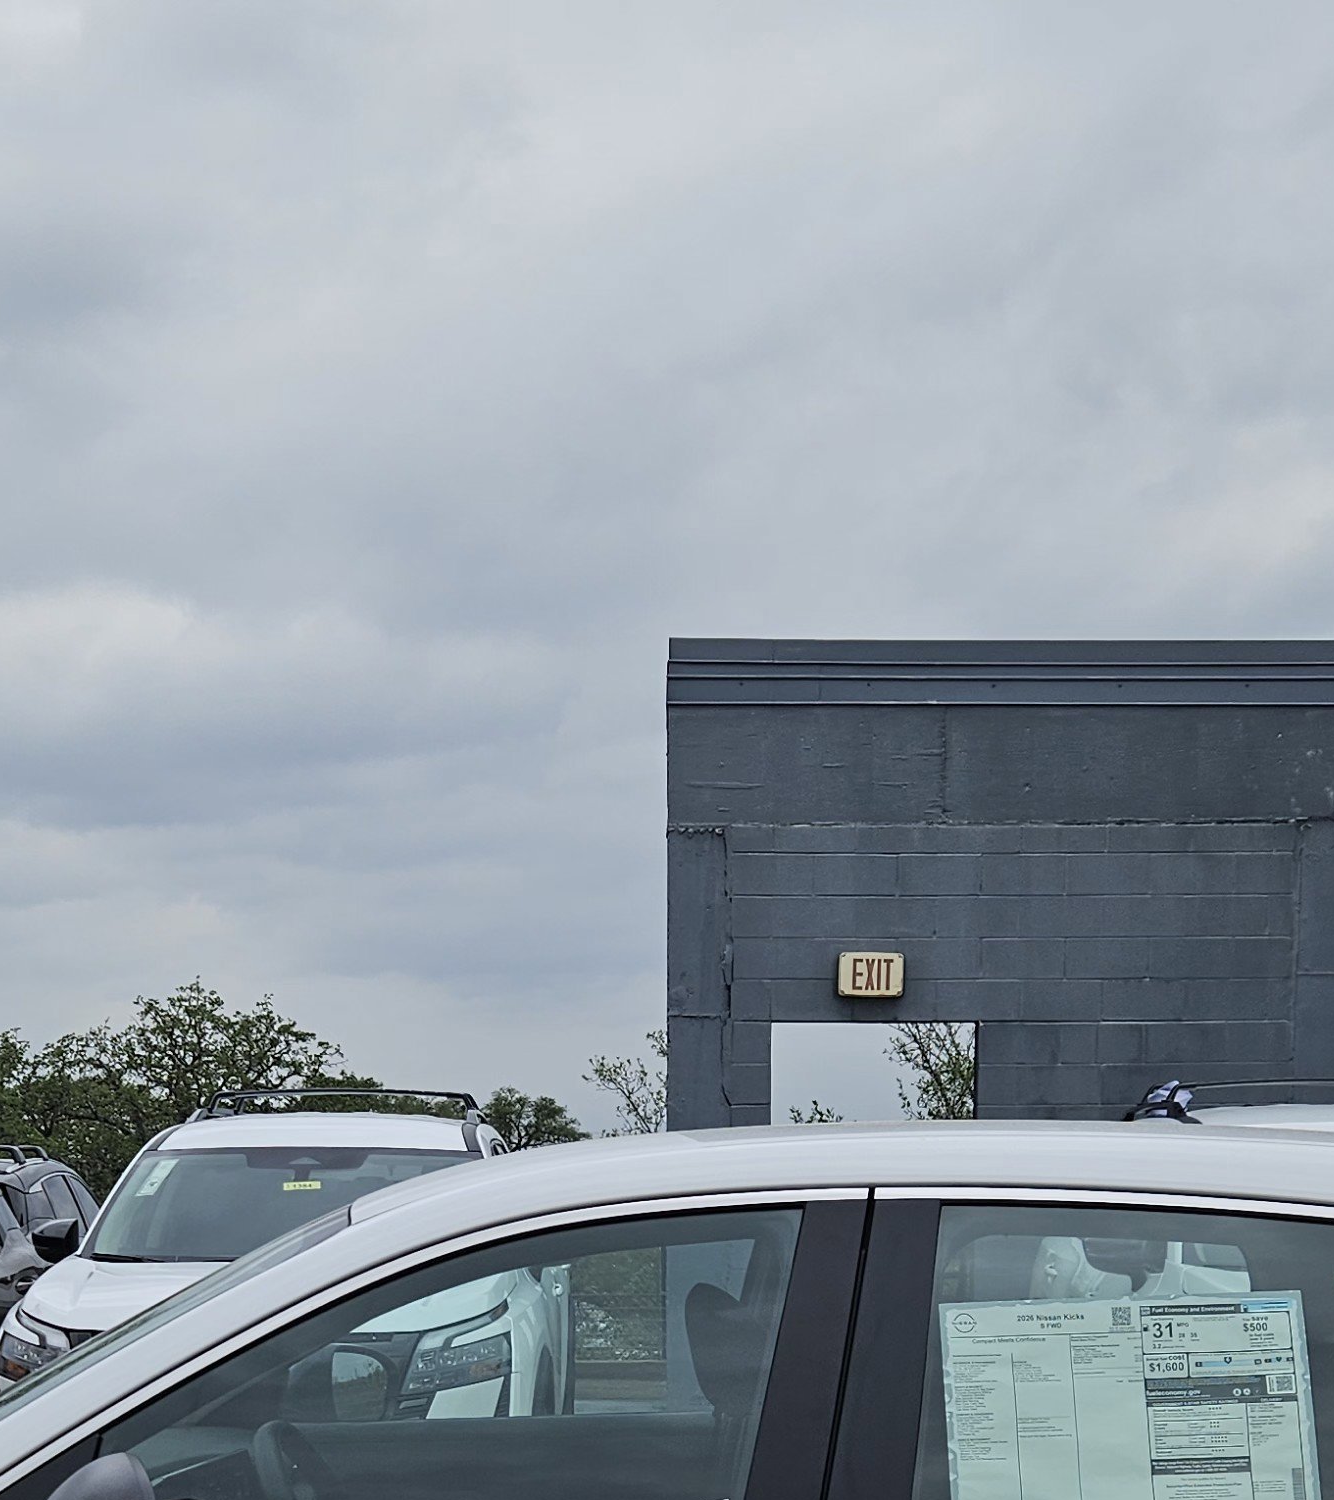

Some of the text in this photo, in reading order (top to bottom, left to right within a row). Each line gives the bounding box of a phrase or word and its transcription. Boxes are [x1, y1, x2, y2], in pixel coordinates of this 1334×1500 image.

[852, 959, 894, 990] EXIT
[1152, 1322, 1173, 1339] 31
[1243, 1322, 1268, 1332] $500
[1148, 1361, 1185, 1373] $1,600
[1146, 1388, 1202, 1397] fueleconomy.gov
